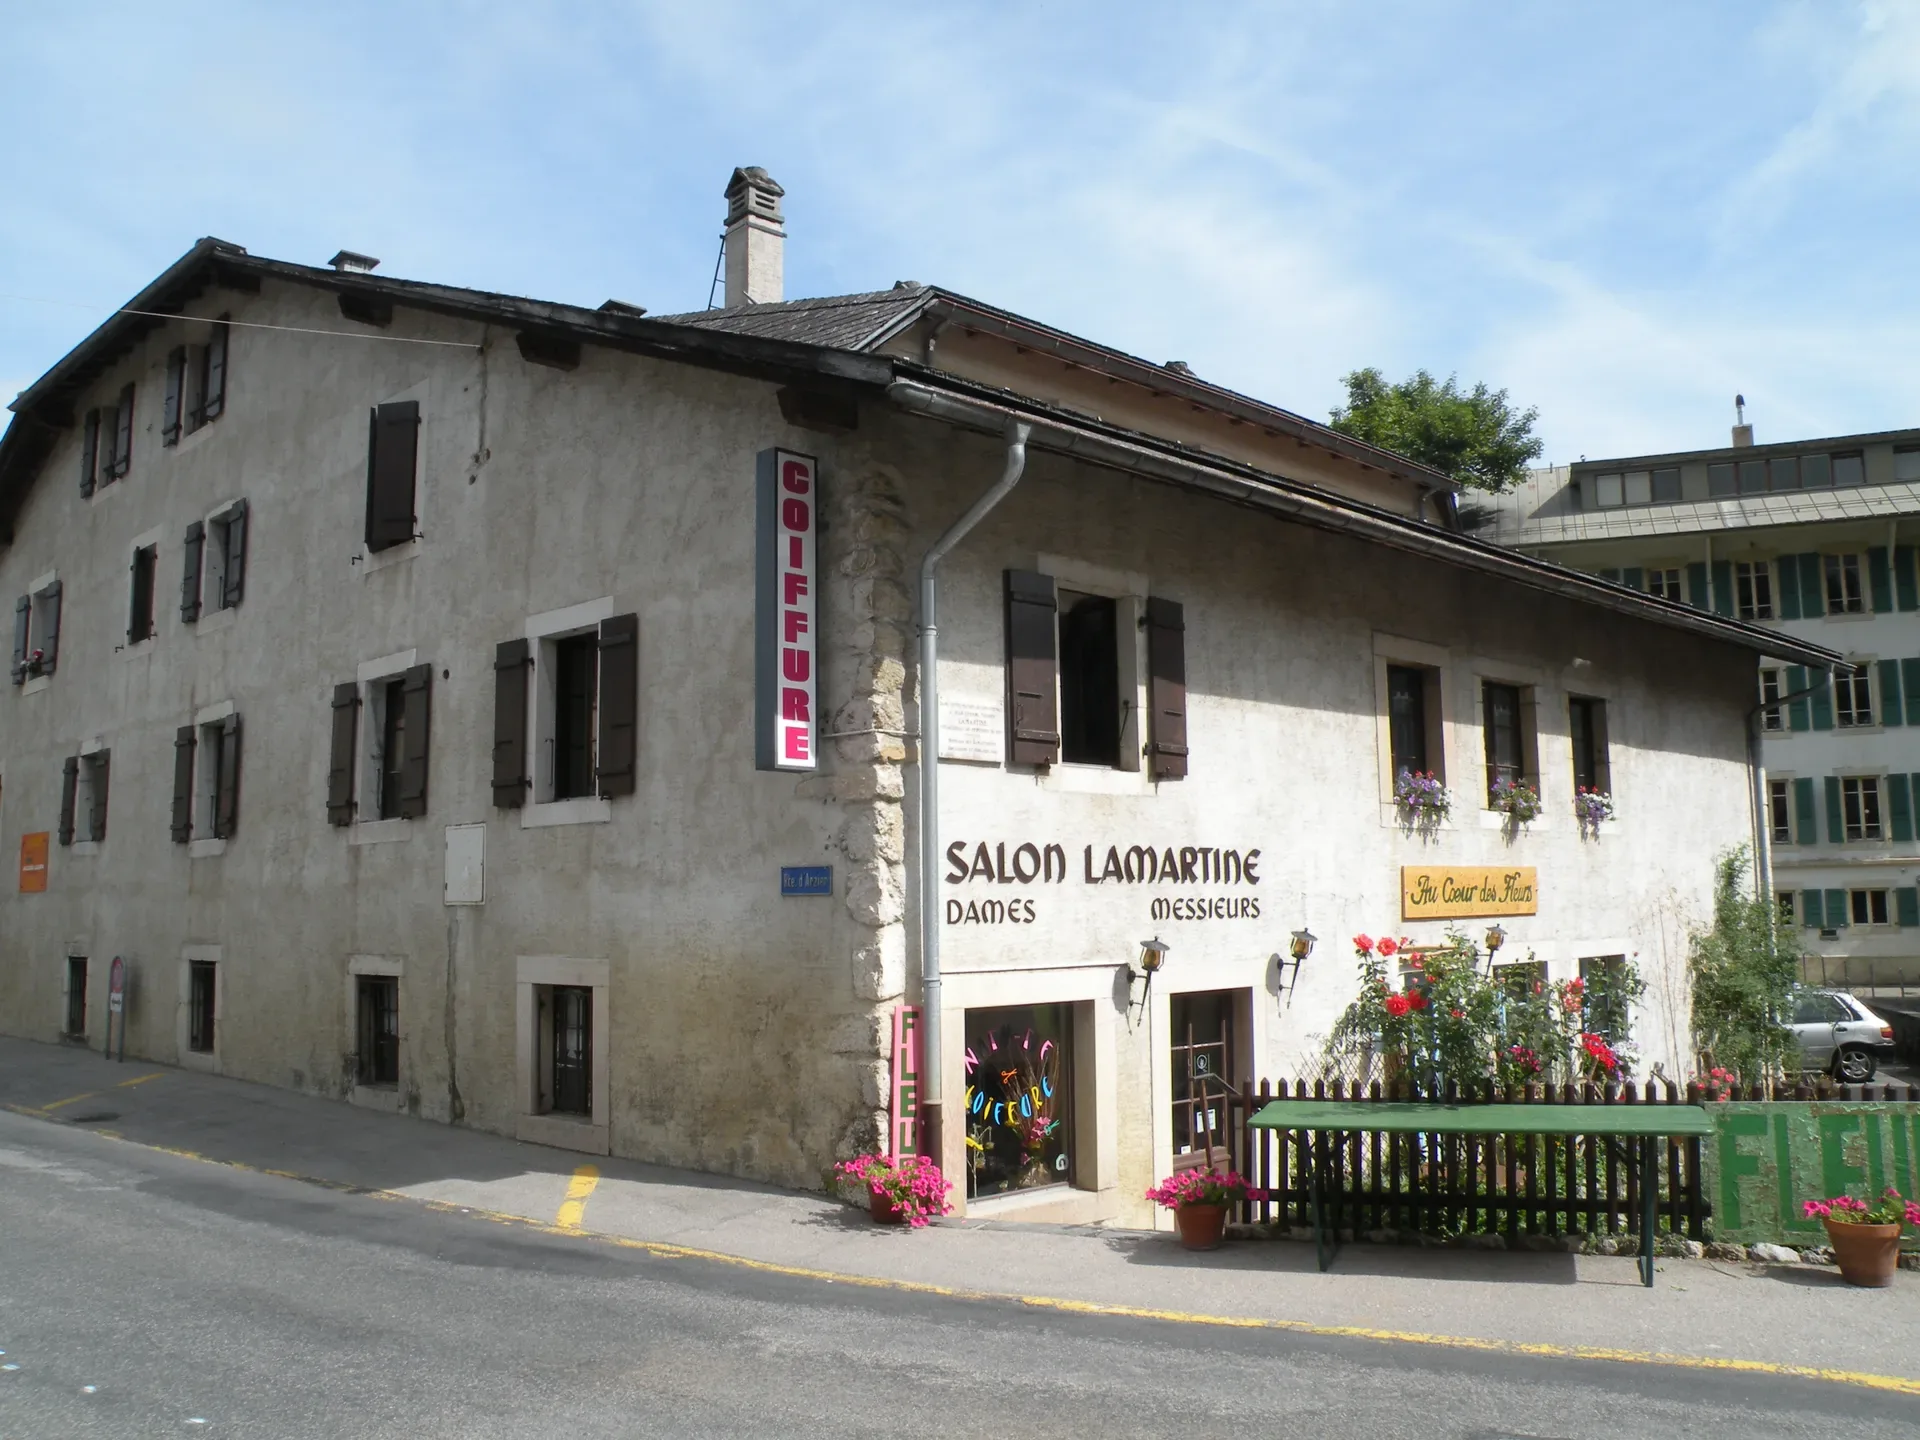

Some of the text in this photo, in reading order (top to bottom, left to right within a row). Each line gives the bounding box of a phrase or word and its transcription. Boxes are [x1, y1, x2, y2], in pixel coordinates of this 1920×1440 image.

[782, 459, 810, 761] COIFFURE
[944, 841, 1262, 885] SALON LAMARTINE
[1410, 875, 1439, 905] Au
[1480, 875, 1497, 902] des
[1500, 871, 1533, 903] Fleurs
[946, 898, 1036, 924] DAMES
[1151, 896, 1261, 920] MESSIEURS
[1716, 1113, 1920, 1230] FLEU
